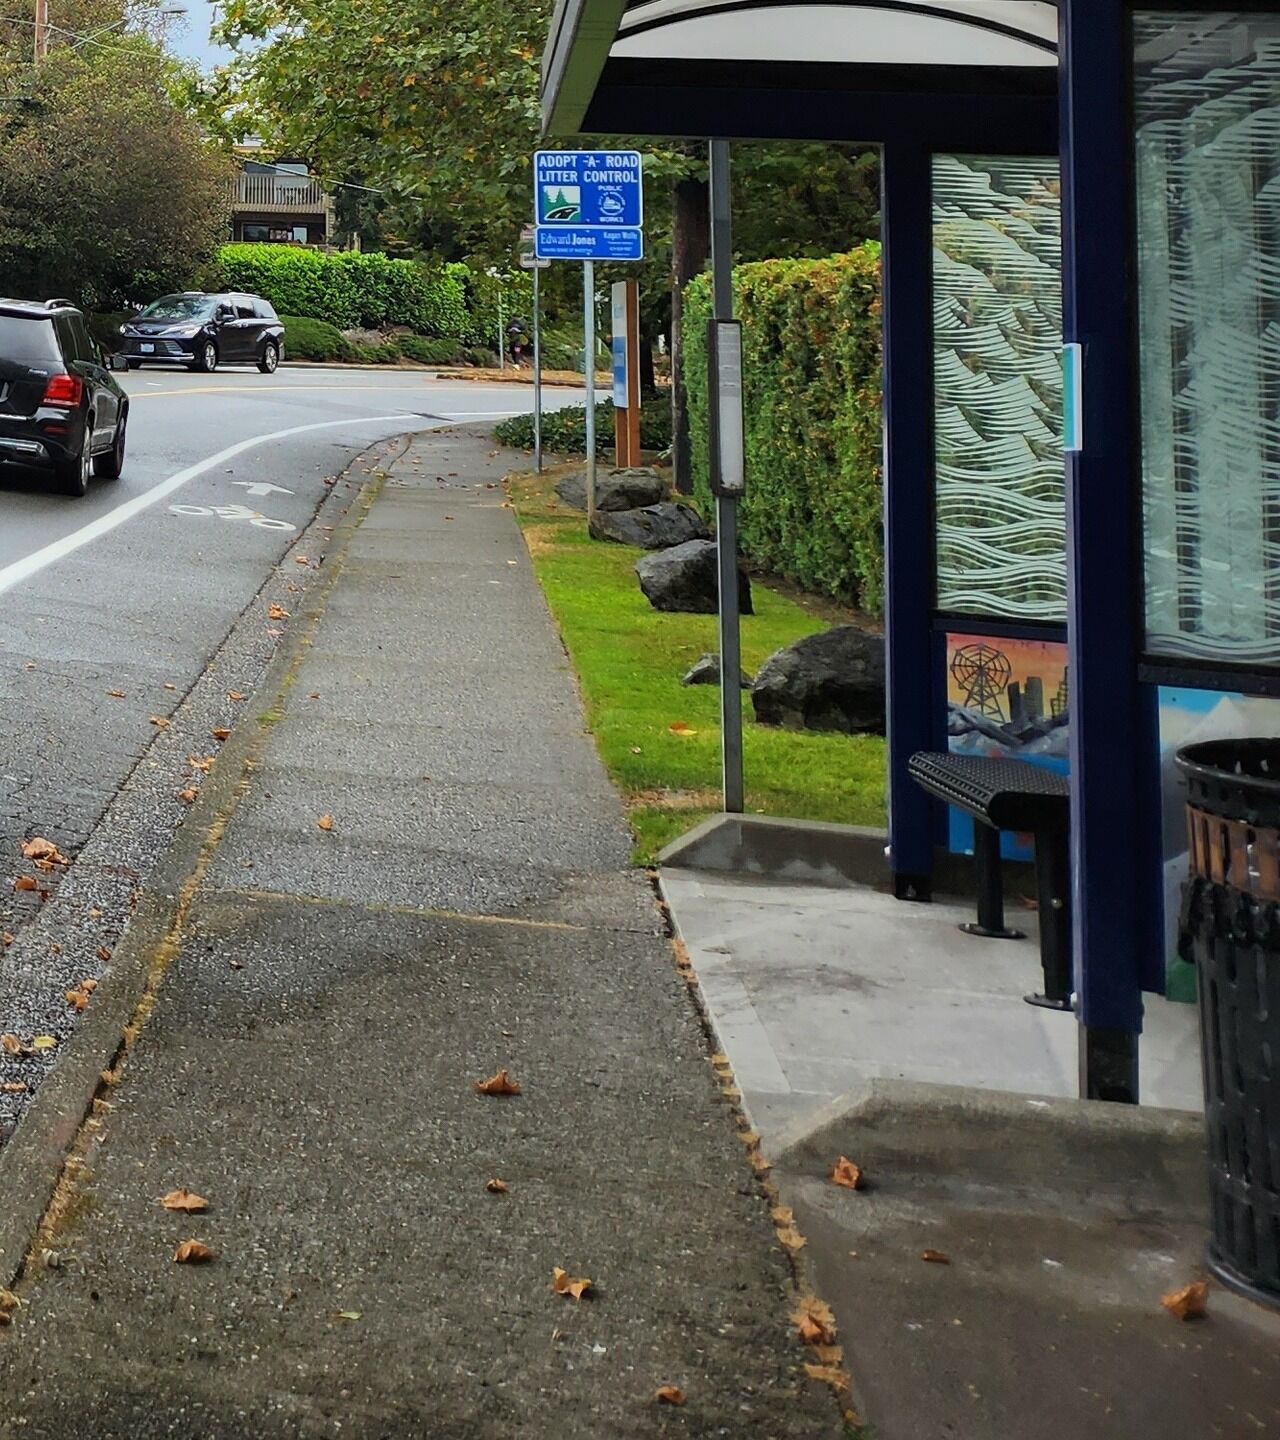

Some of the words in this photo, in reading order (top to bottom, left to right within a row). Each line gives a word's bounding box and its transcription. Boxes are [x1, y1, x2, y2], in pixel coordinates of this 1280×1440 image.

[539, 155, 577, 168] ADOPT
[606, 155, 638, 168] ROAD
[539, 170, 578, 182] LITTER
[583, 170, 638, 183] CONTROL
[540, 233, 571, 245] Edward
[572, 233, 596, 246] Jones
